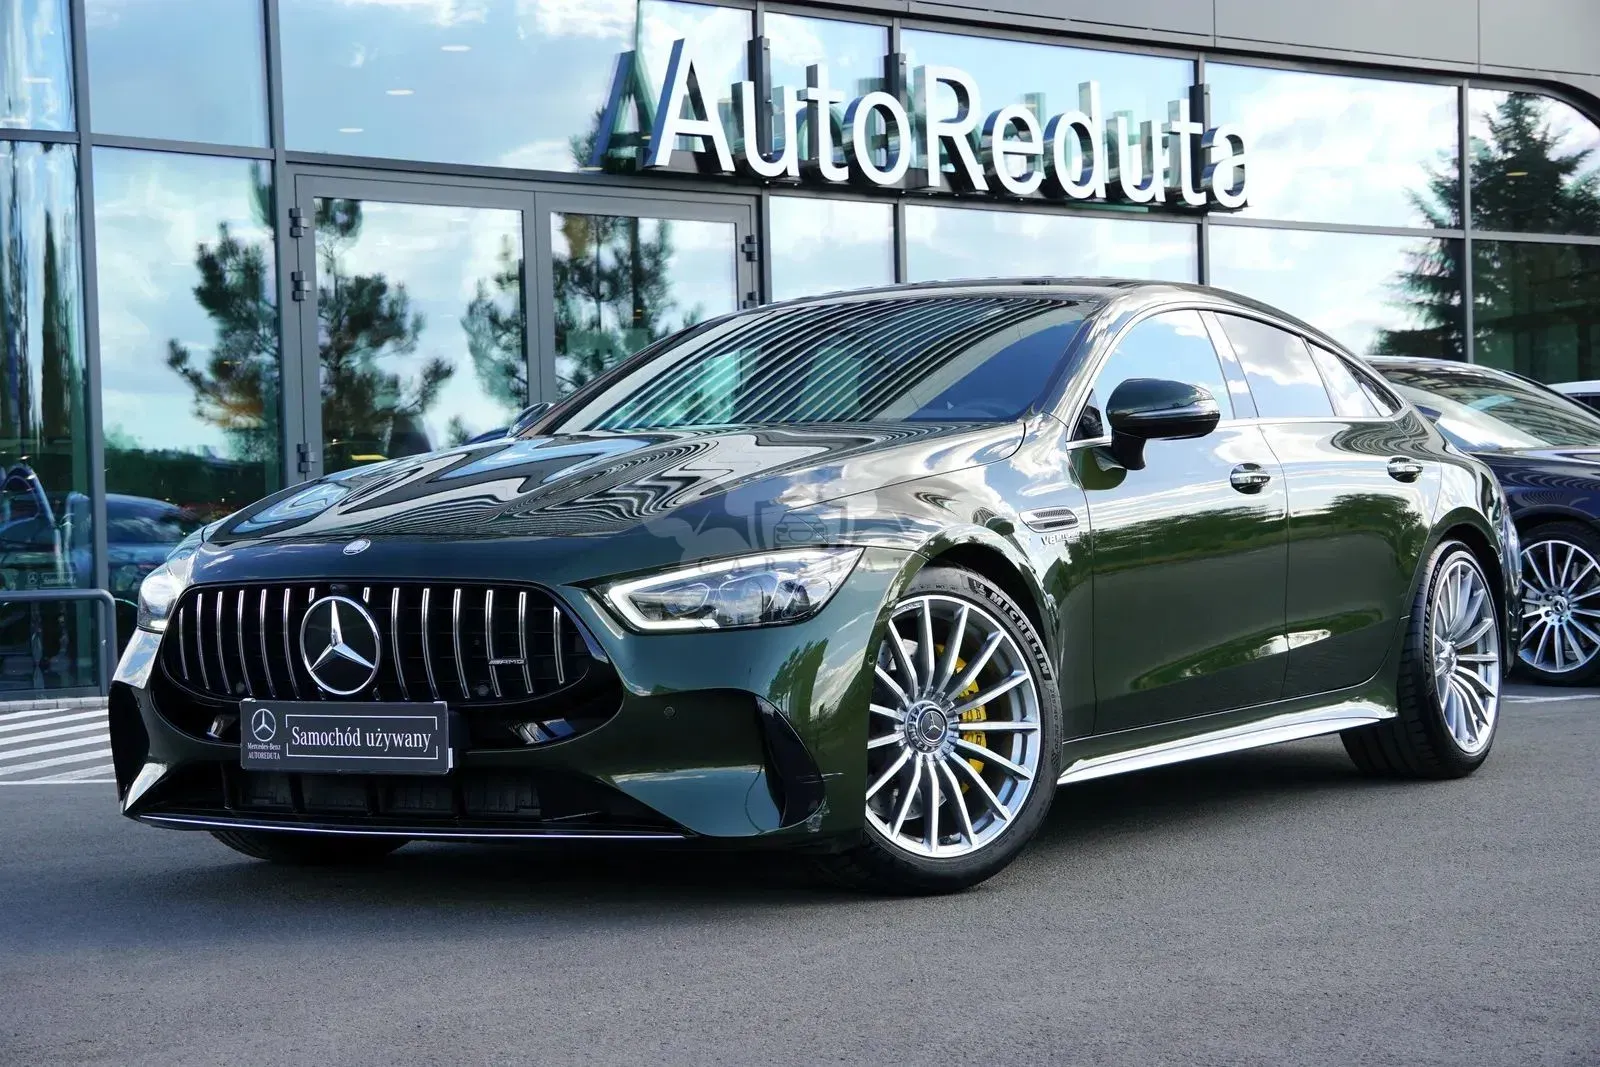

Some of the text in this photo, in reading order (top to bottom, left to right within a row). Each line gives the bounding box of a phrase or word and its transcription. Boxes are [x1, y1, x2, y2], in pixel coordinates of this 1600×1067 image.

[648, 38, 1249, 208] AutoReduta
[986, 592, 1050, 677] MICHELIN
[248, 752, 281, 760] AUTOREDUTA
[291, 725, 432, 753] Samochód używany
